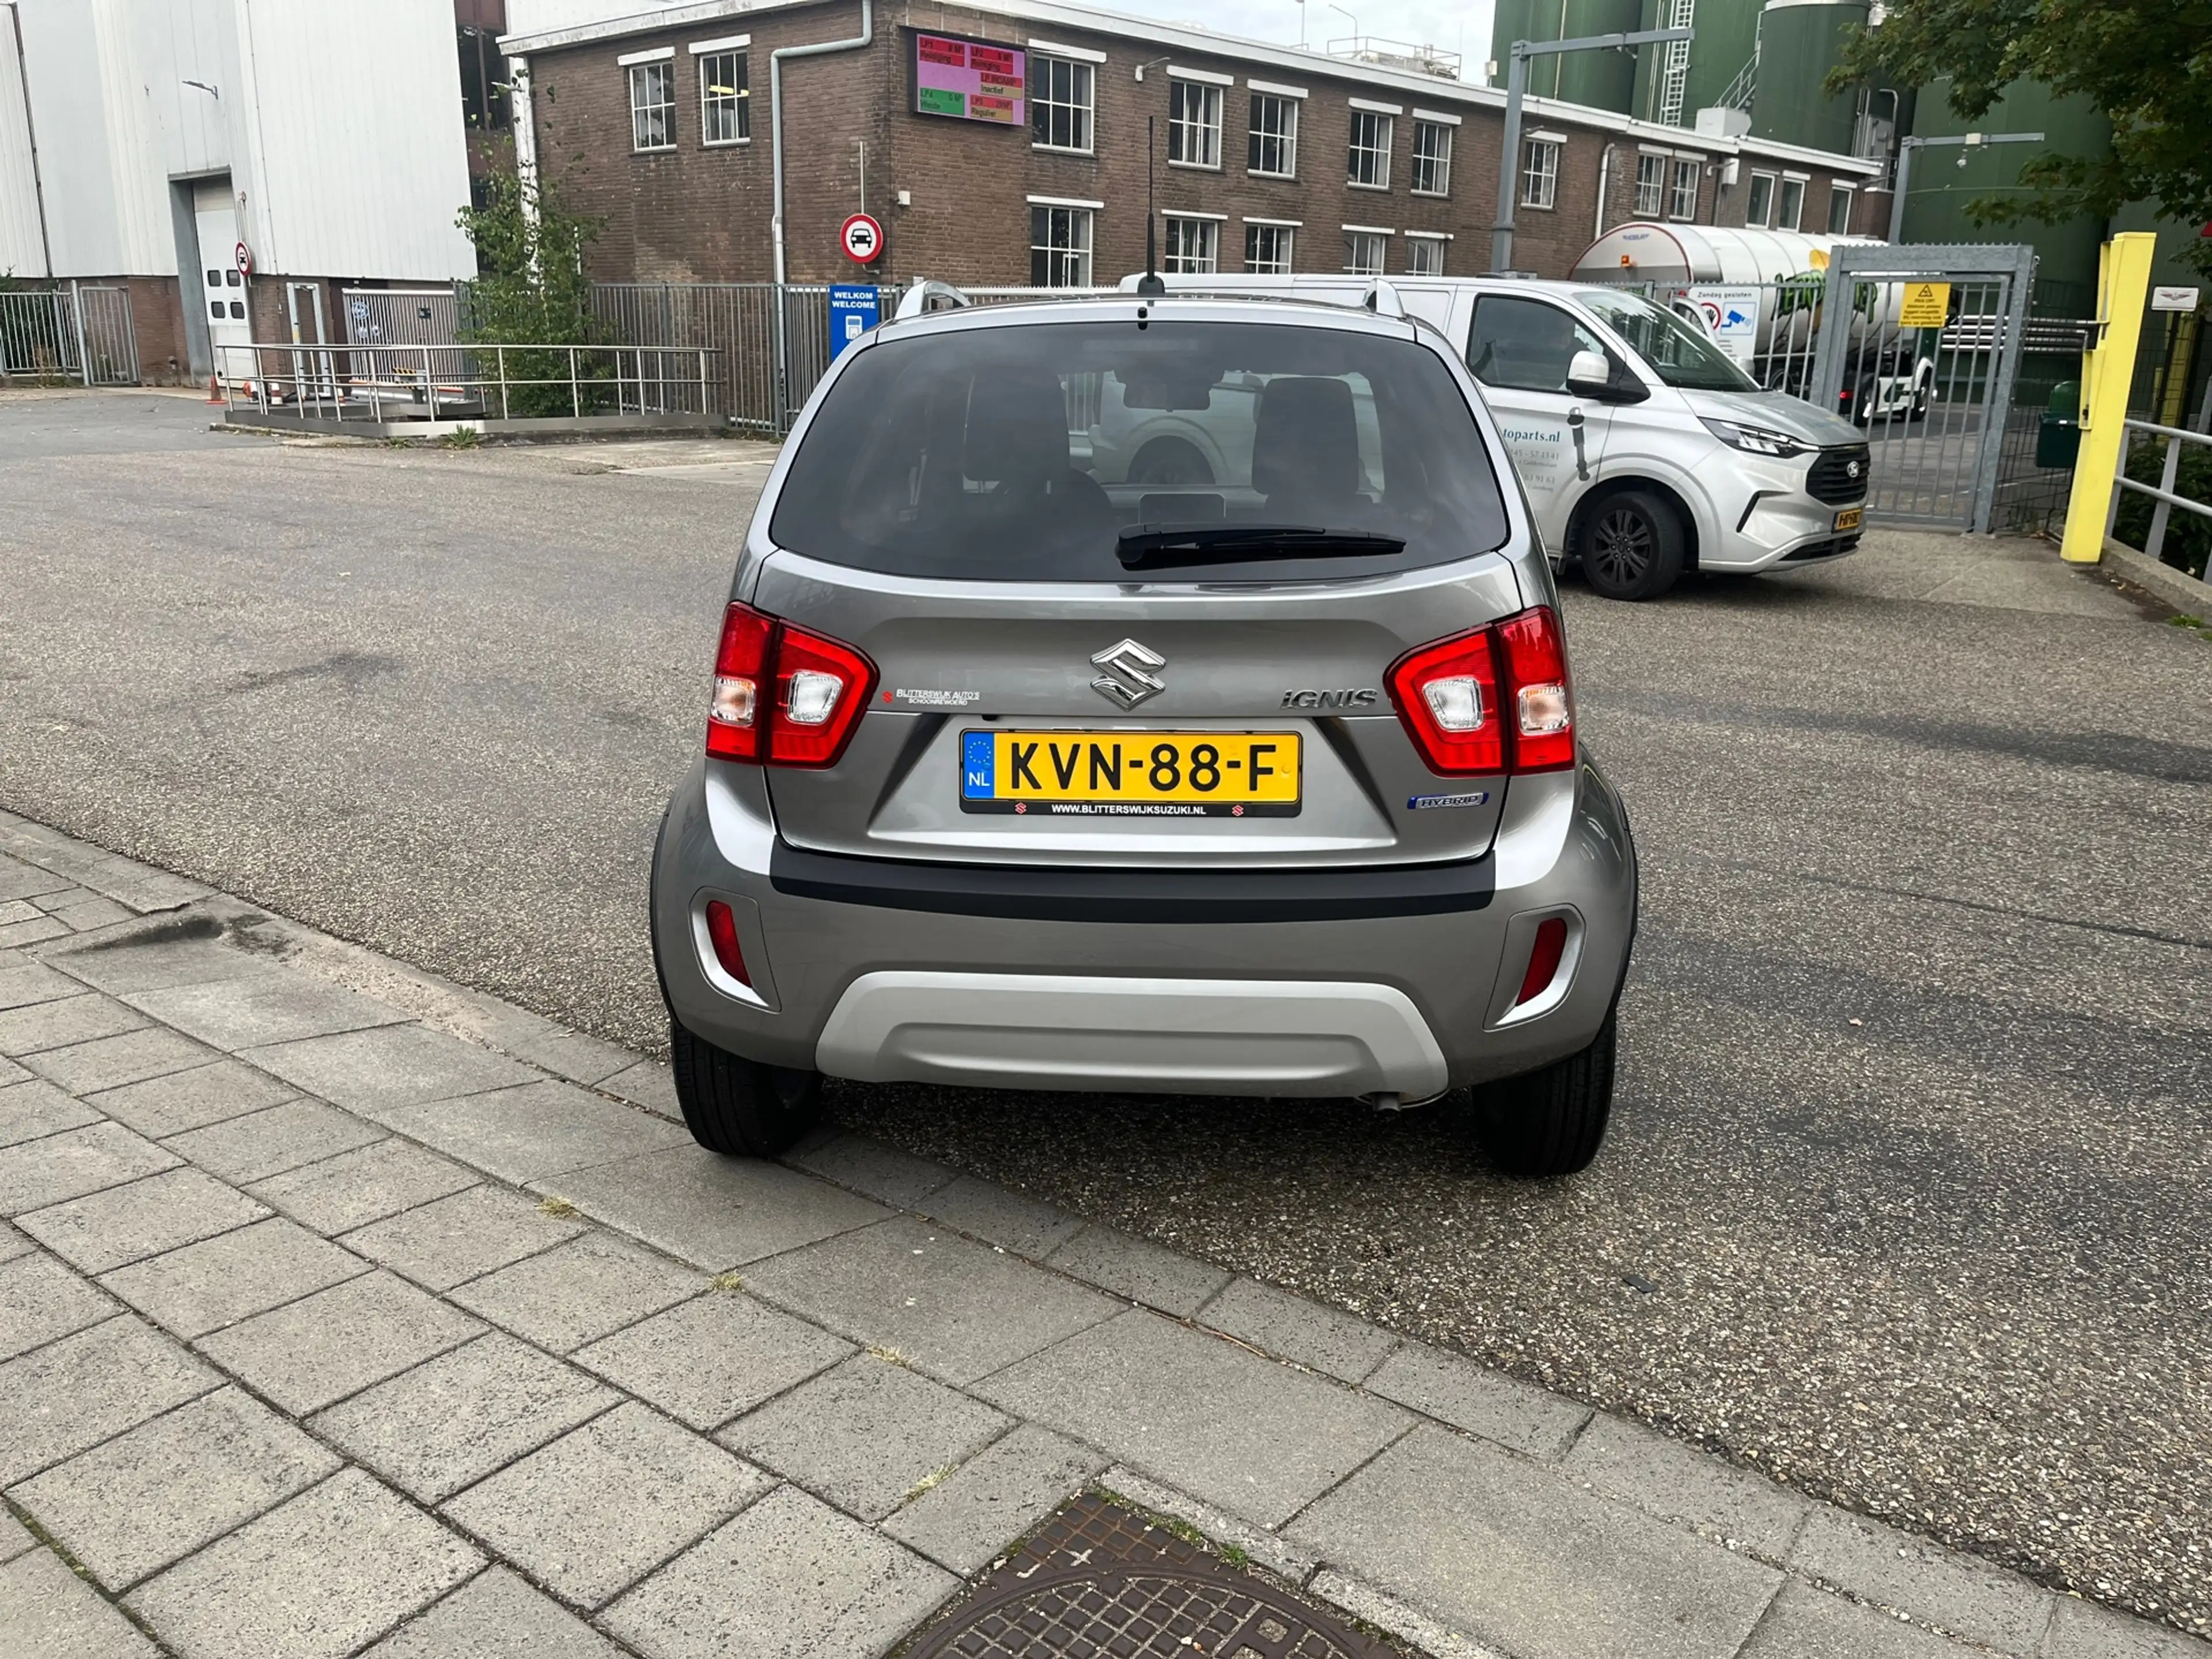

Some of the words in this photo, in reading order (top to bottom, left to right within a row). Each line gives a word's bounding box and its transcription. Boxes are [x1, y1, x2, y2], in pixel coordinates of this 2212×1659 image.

[834, 291, 873, 300] WELKOM
[832, 300, 876, 309] WELCOME
[1280, 688, 1378, 710] IGNIS
[1011, 743, 1277, 791] KVN-88-F
[969, 772, 990, 787] NL
[1421, 796, 1478, 806] HYBRID
[1052, 804, 1207, 815] WWW.BLITTERSWIJKSUZUKI.NL
